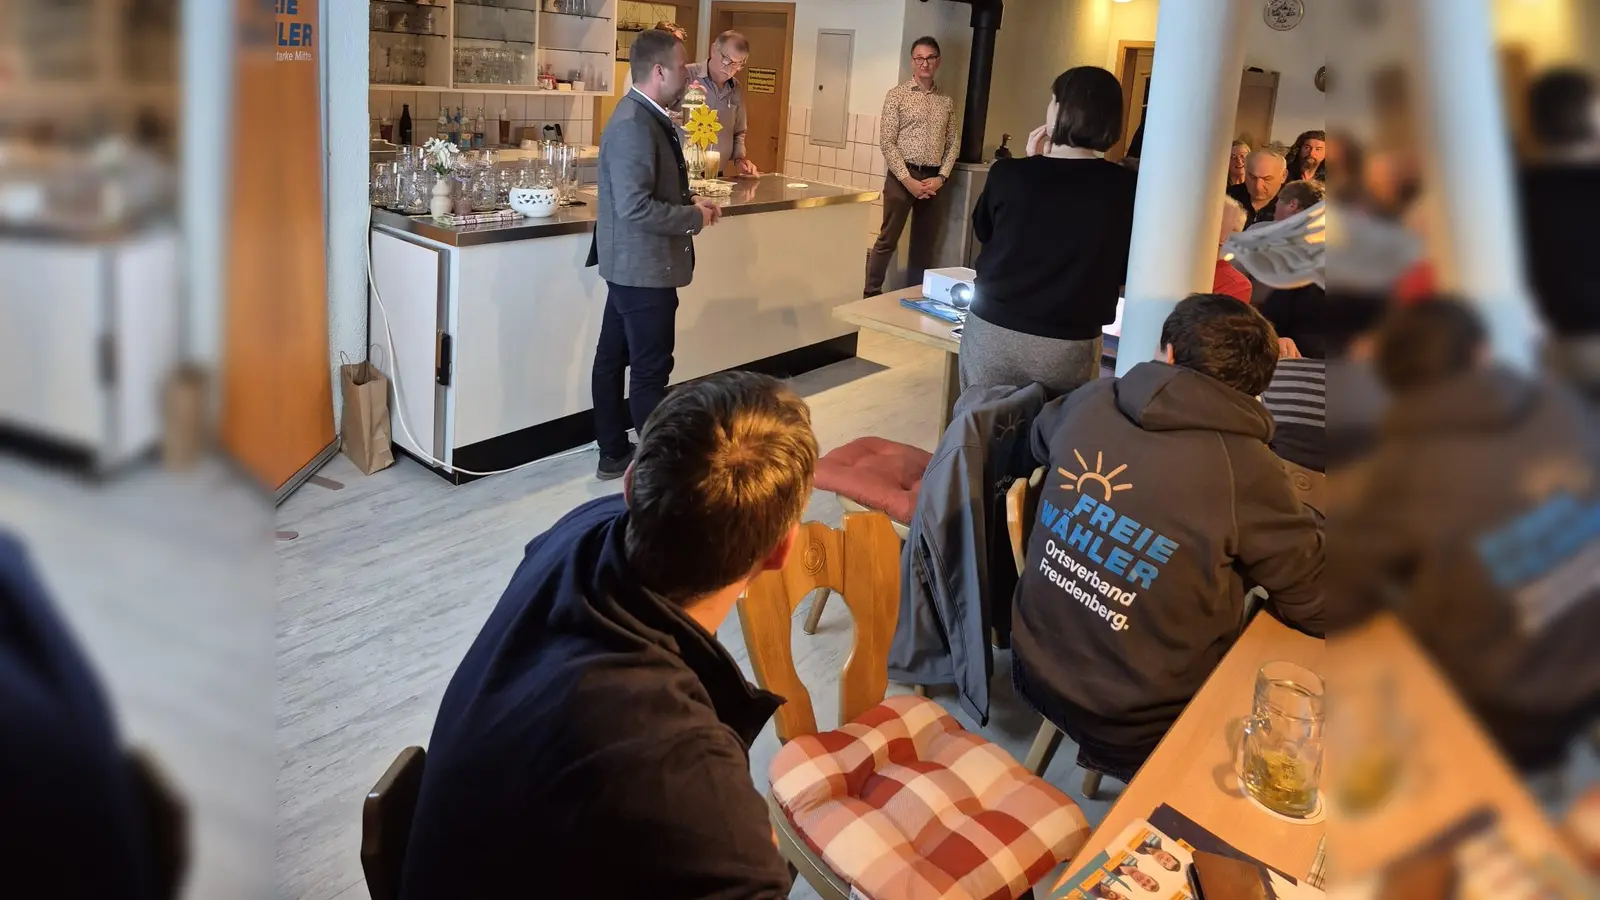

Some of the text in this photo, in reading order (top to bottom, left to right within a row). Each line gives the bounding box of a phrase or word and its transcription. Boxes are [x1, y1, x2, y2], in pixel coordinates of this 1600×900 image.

[275, 0, 298, 14] IE
[275, 22, 312, 46] LER
[1040, 498, 1159, 590] WÄHLER
[1072, 493, 1180, 564] FREIE
[1039, 557, 1130, 631] Freudenberg.
[1045, 539, 1137, 607] Ortsverband
